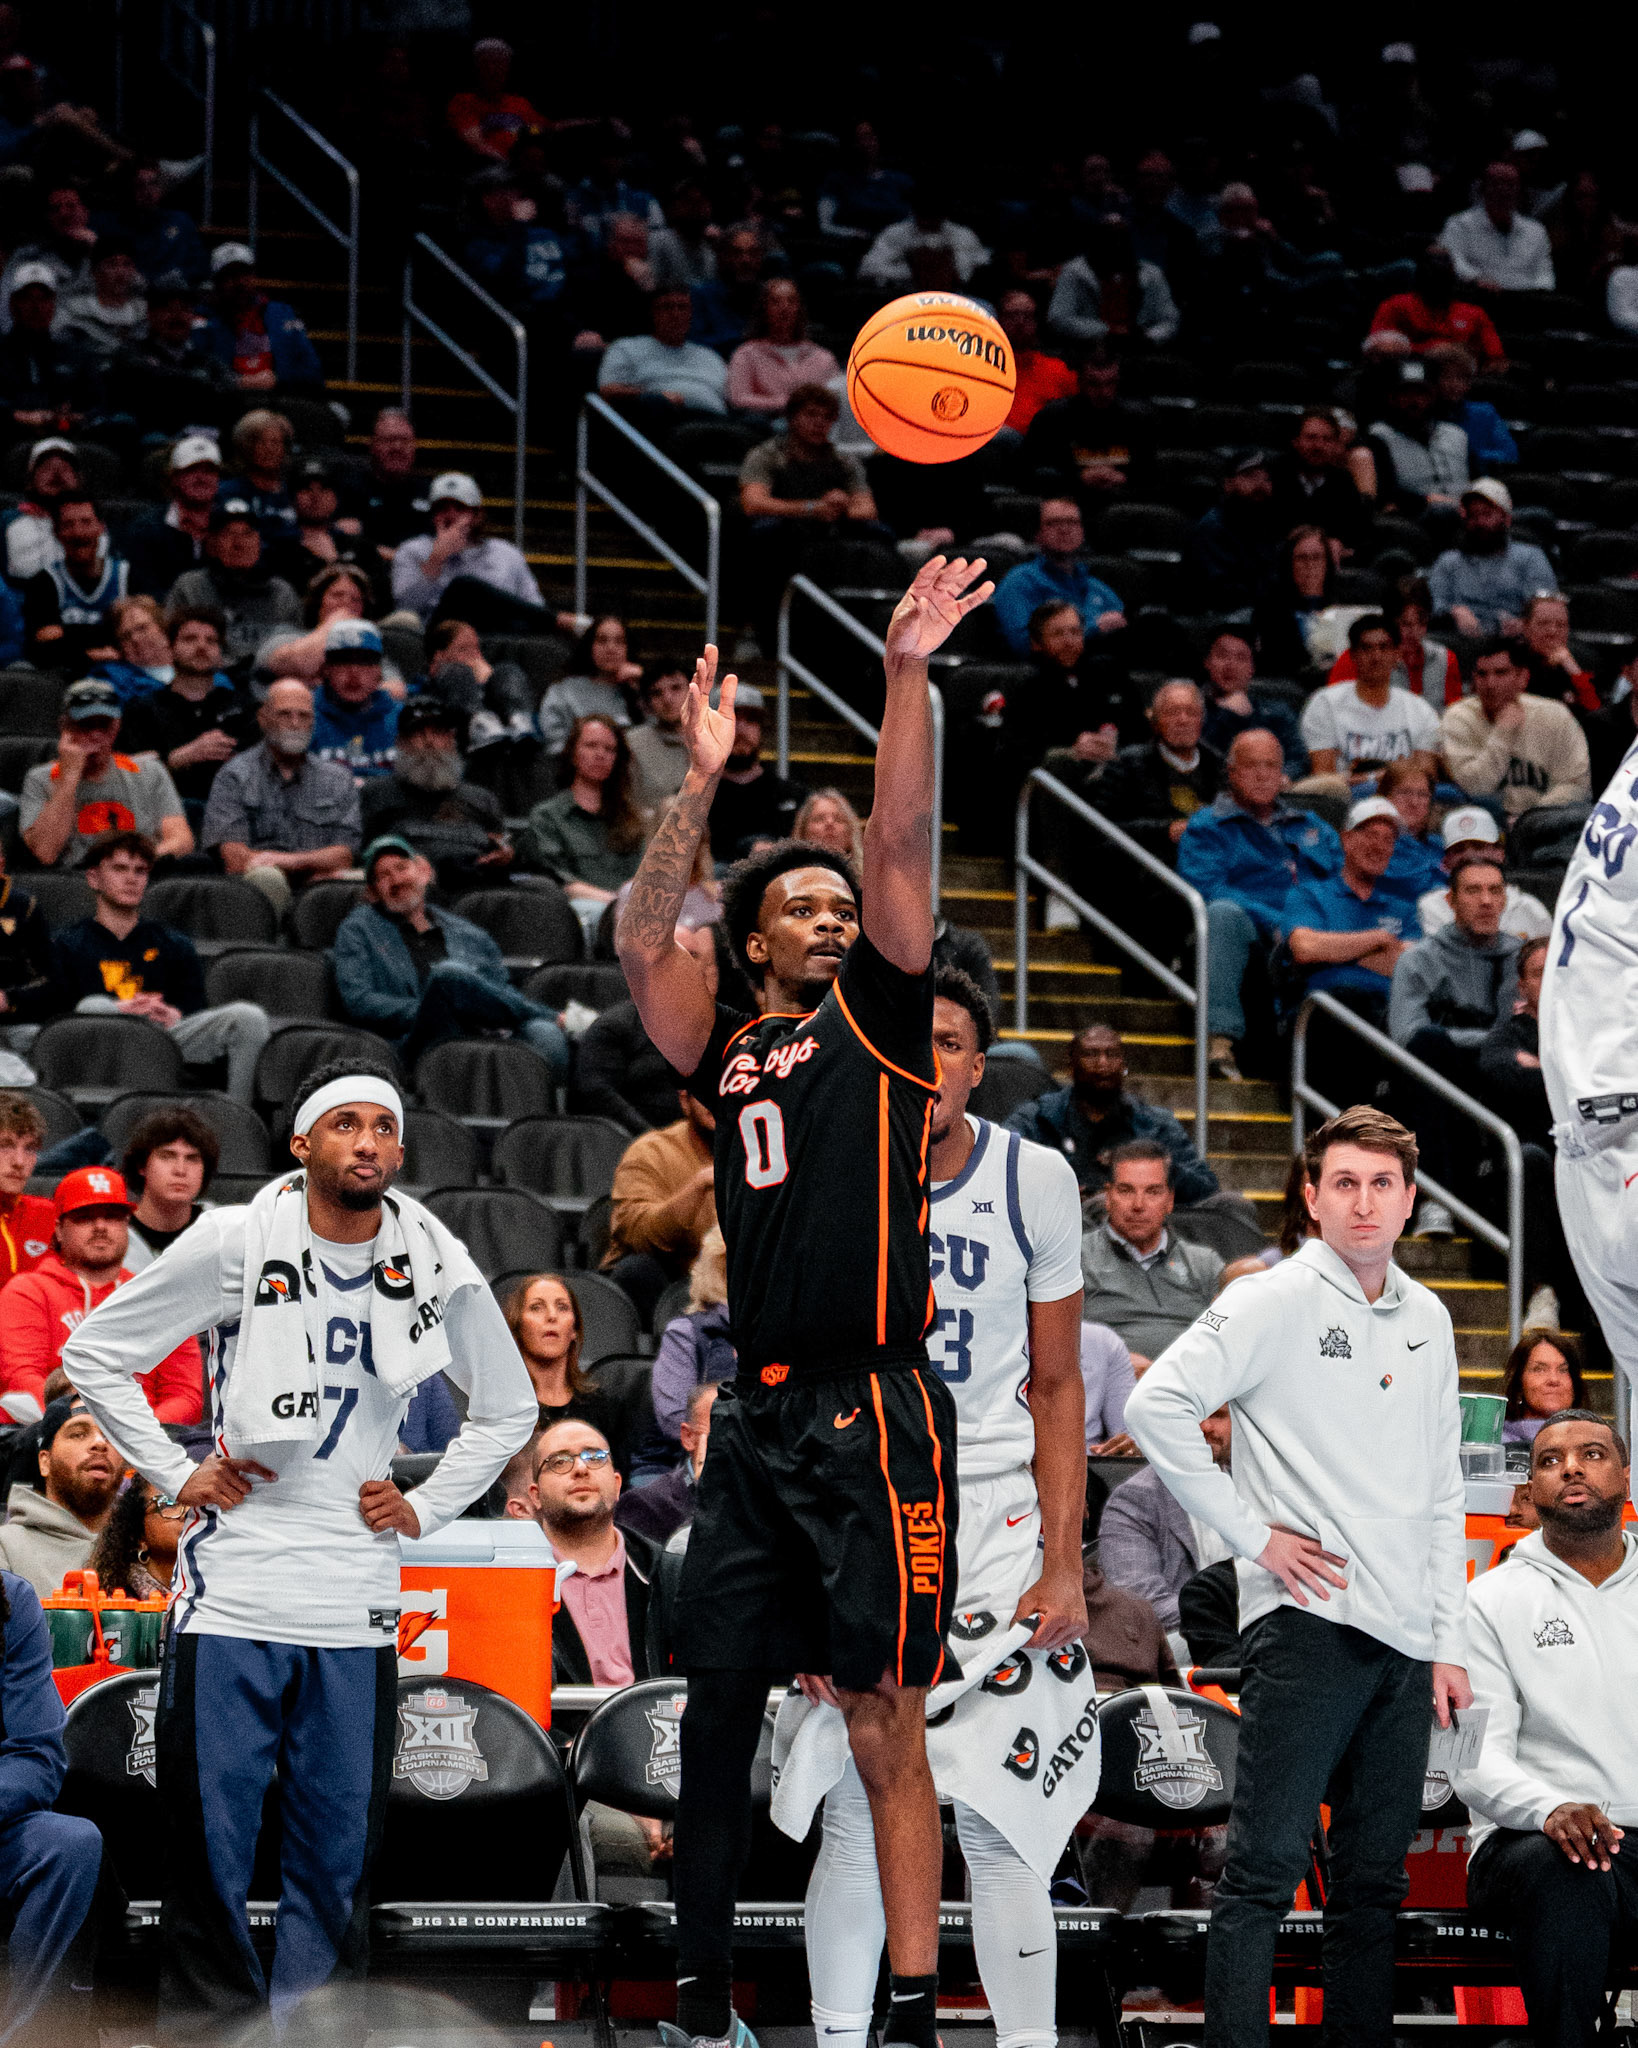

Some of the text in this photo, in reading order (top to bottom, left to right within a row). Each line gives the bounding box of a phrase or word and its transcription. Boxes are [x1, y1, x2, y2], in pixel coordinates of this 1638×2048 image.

[906, 325, 1007, 374] Wilson
[738, 1098, 790, 1190] 0
[972, 1200, 995, 1214] XII
[760, 1363, 790, 1386] OSU
[313, 1385, 359, 1460] 7
[902, 1501, 941, 1594] POKES
[403, 1712, 473, 1750] XII
[401, 1753, 480, 1766] BASKETBALL
[399, 1760, 482, 1774] TOURNAMENT
[1141, 1763, 1214, 1777] BASKETBALL
[1140, 1771, 1217, 1784] TOURNAMENT
[412, 1917, 587, 1926] BIG 12 CONFERENCE
[1437, 1927, 1464, 1936] BIG
[1471, 1928, 1488, 1938] 12
